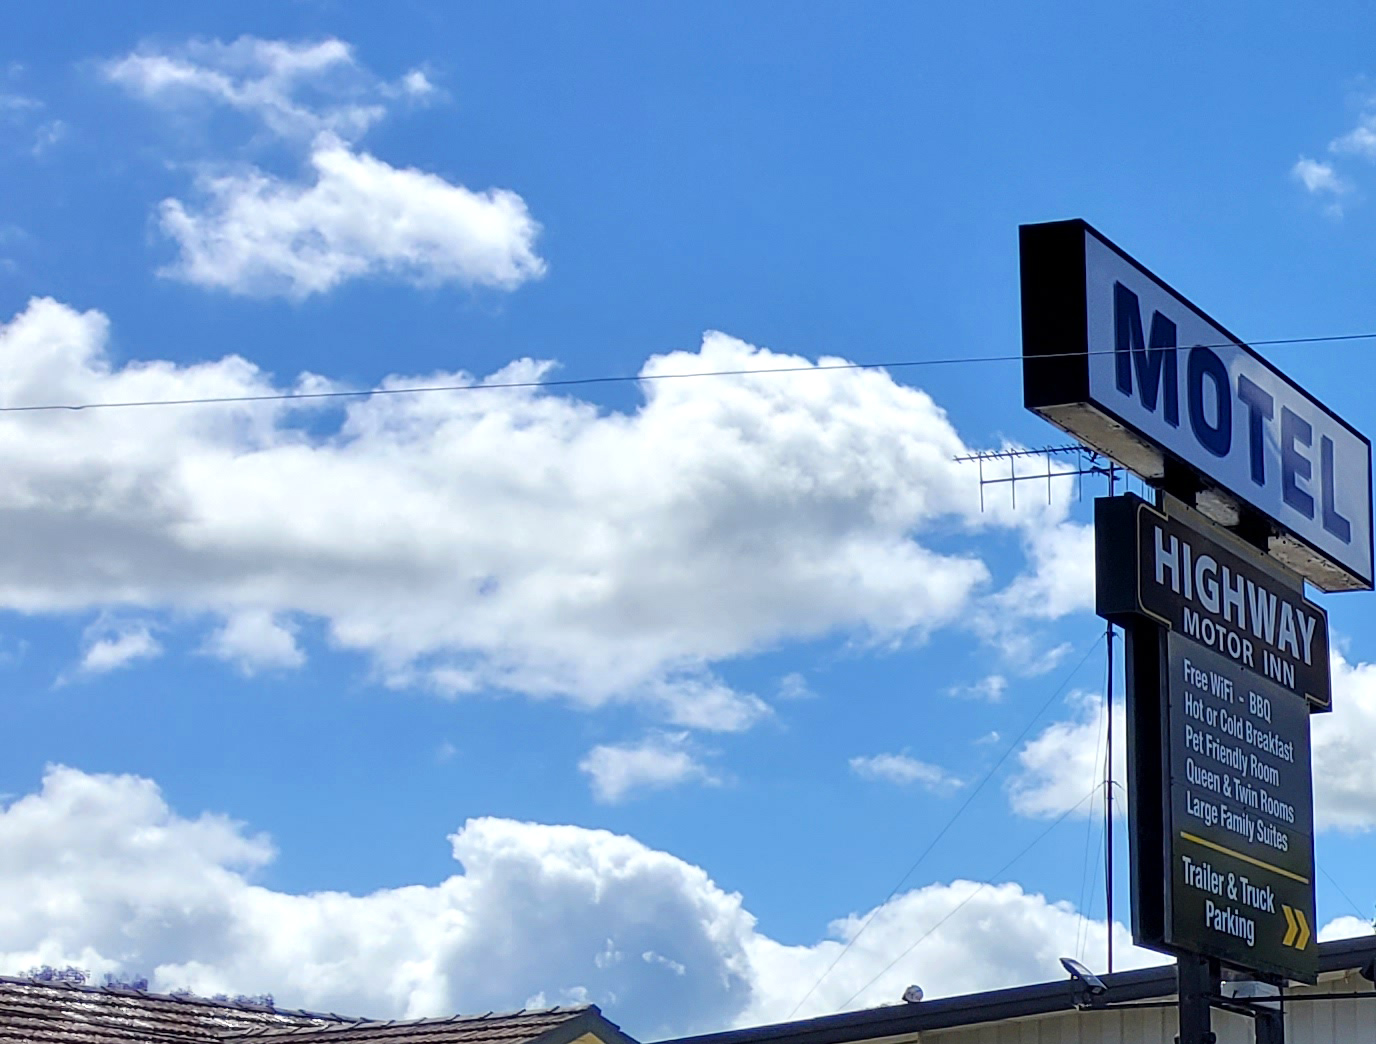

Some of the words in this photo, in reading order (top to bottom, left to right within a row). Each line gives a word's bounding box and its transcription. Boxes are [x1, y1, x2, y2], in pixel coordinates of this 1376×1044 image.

[1113, 279, 1352, 544] MOTEL
[1154, 525, 1317, 666] HIGHWAY
[1183, 606, 1254, 668] MOTOR
[1263, 650, 1295, 689] INN
[1184, 658, 1209, 692] Free
[1210, 671, 1234, 704] WiFi
[1249, 691, 1272, 724] BBQ
[1185, 691, 1205, 722] Hot
[1206, 706, 1218, 728] or
[1220, 708, 1244, 740] Cold
[1246, 720, 1294, 763] Breakfast
[1186, 724, 1204, 755] Pet
[1206, 733, 1248, 777] Friendly
[1250, 753, 1280, 787] Room
[1186, 757, 1221, 793] Queen
[1223, 774, 1232, 798] &
[1233, 777, 1259, 809] Twin
[1260, 788, 1295, 824] Rooms
[1187, 790, 1218, 826] Large
[1221, 804, 1255, 843] Family
[1257, 819, 1288, 852] Suites
[1182, 855, 1224, 897] Trailer
[1227, 874, 1238, 901] &
[1240, 876, 1276, 915] Truck
[1205, 900, 1255, 947] Parking
